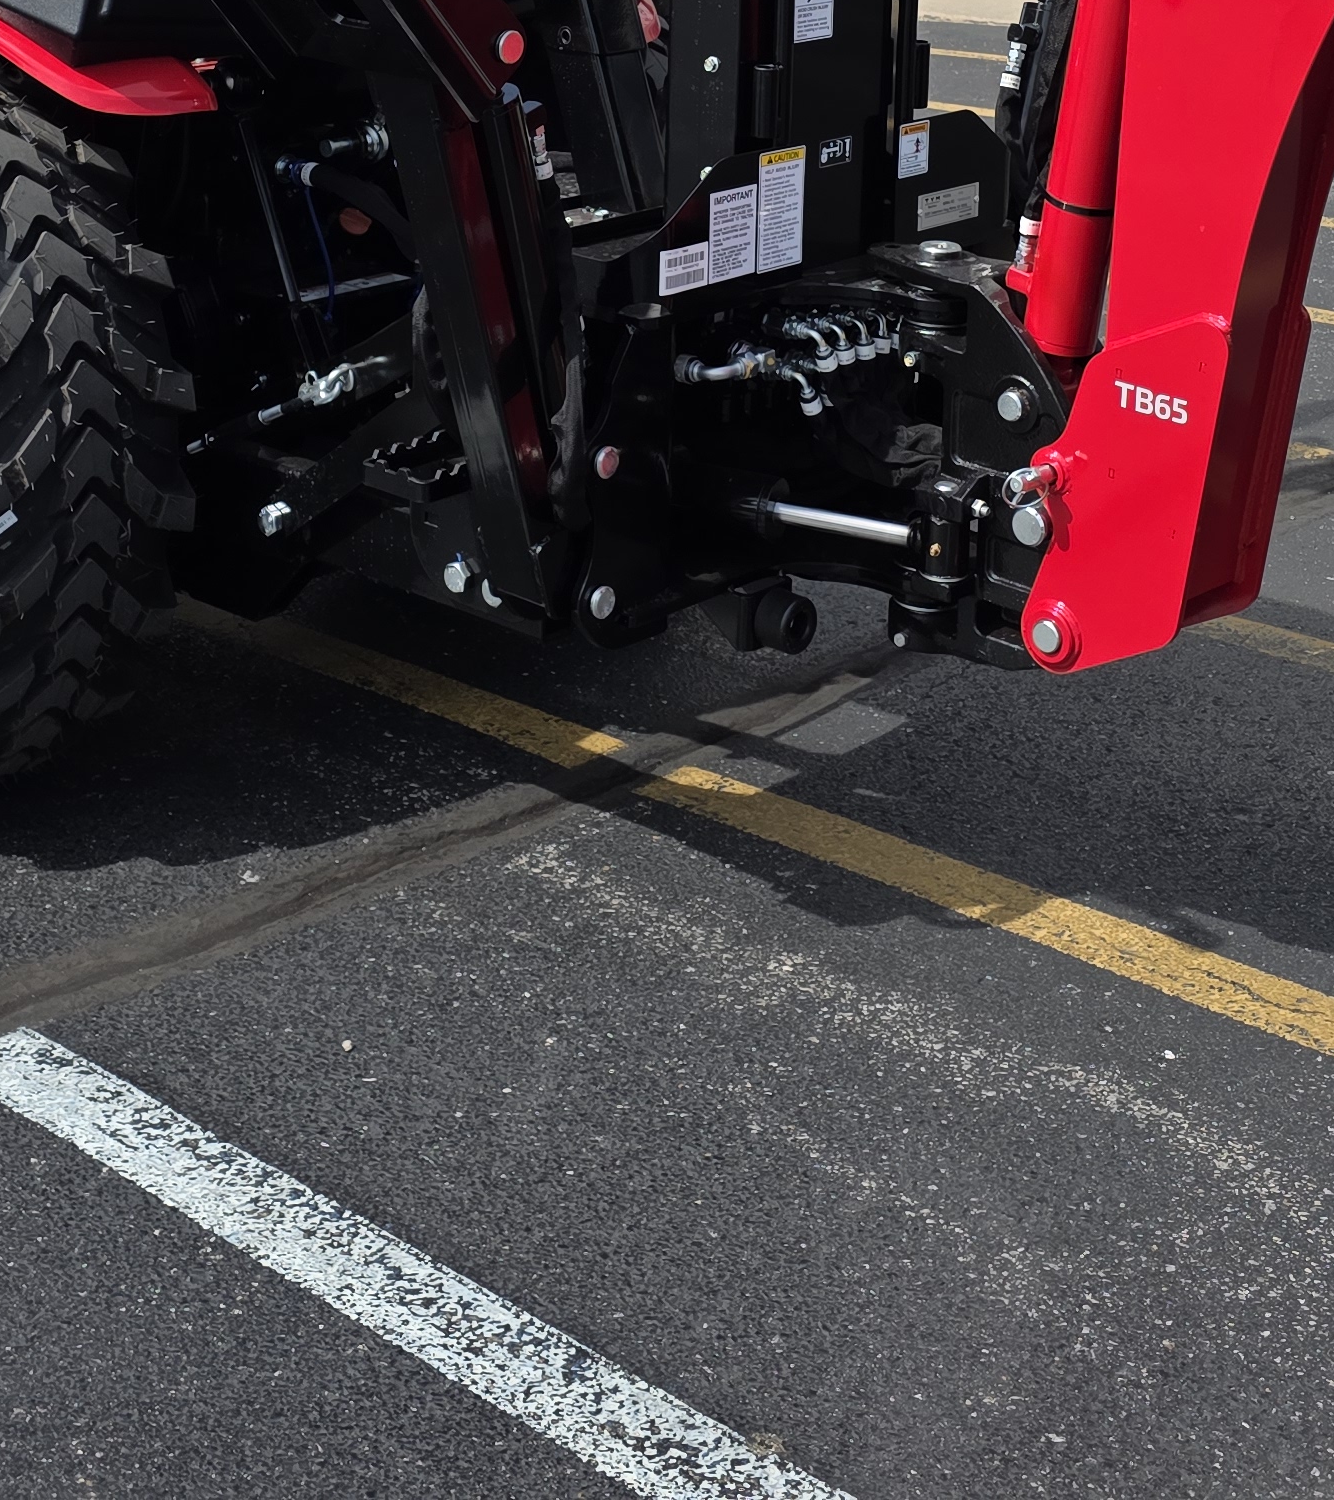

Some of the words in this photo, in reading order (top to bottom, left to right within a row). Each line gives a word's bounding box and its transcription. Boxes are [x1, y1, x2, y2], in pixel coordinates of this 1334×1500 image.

[773, 150, 800, 163] CAUTION
[713, 189, 754, 206] IMPORTANT
[1114, 380, 1188, 425] TB65
